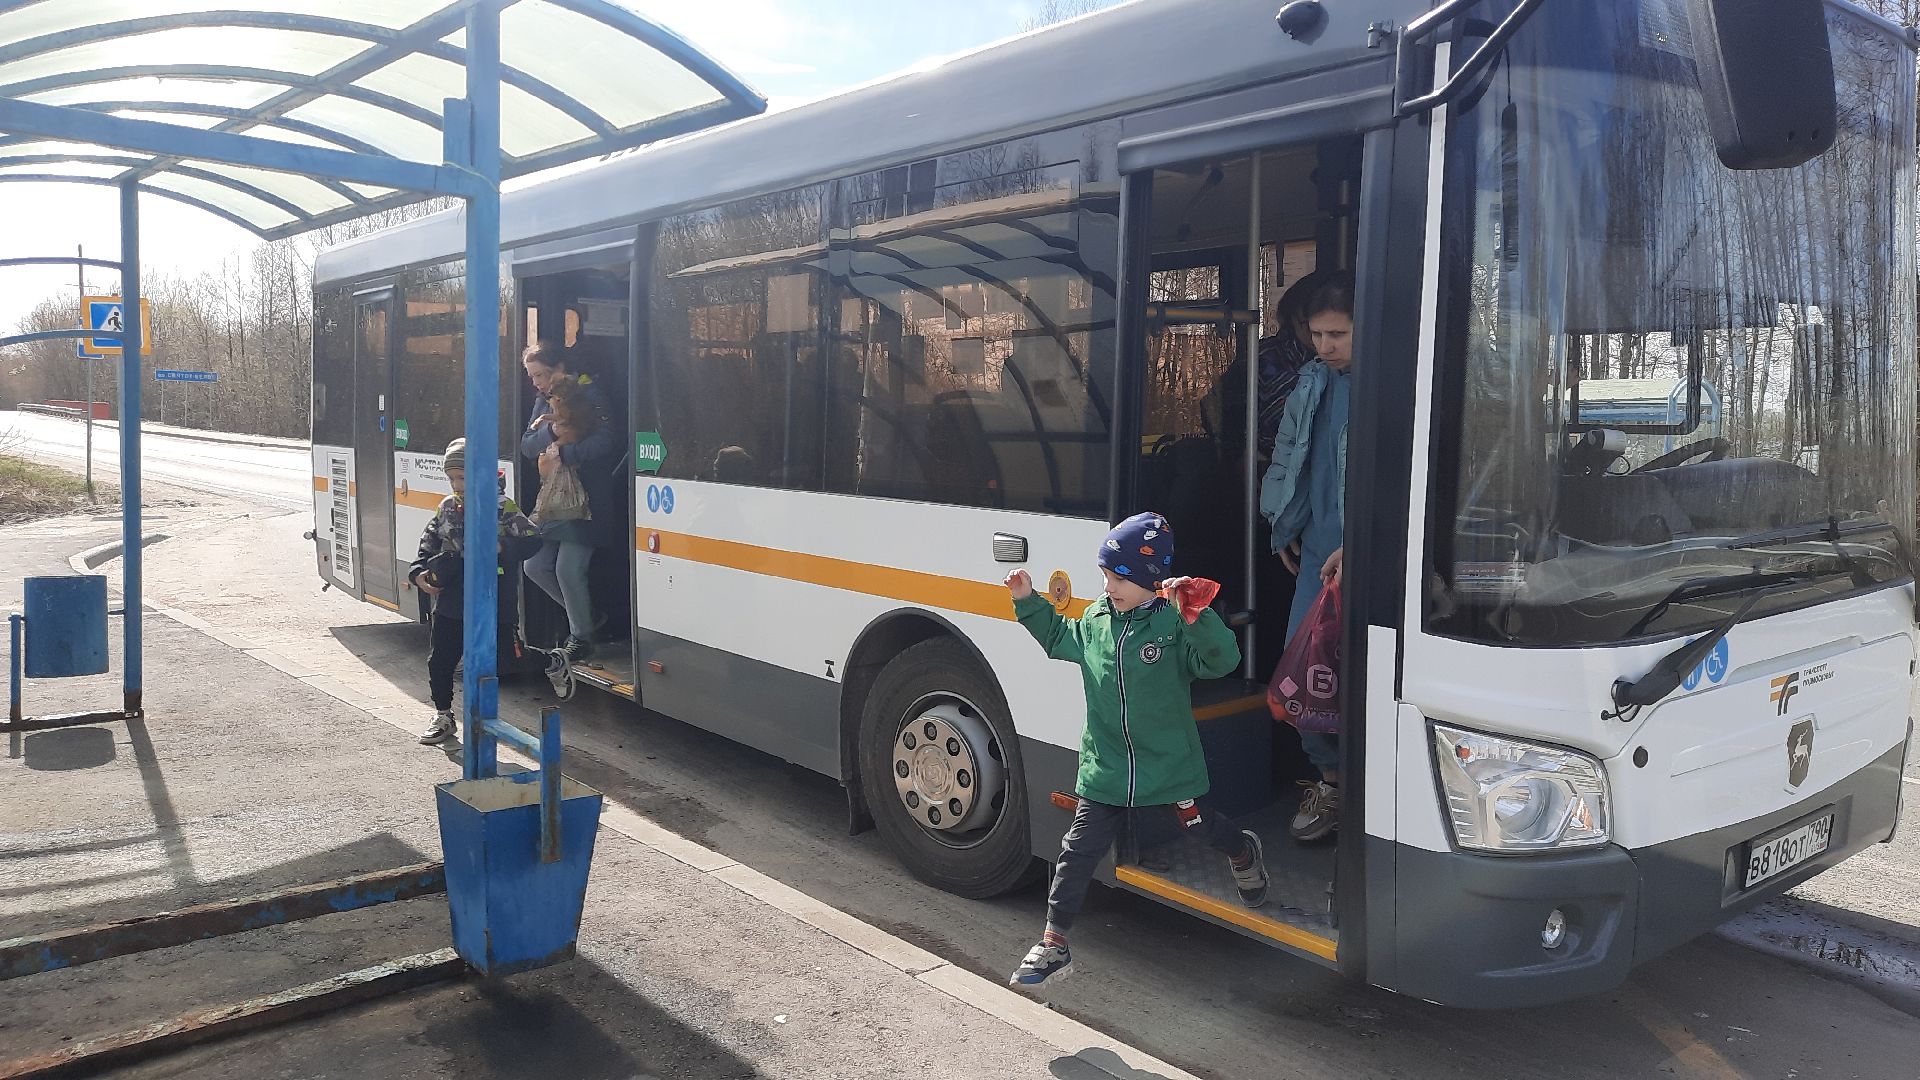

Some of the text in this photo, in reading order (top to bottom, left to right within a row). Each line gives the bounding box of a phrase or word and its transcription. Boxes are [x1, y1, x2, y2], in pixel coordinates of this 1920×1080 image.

[639, 444, 661, 462] ВХОД
[1312, 669, 1333, 694] Б
[1750, 834, 1807, 880] В818ОТ
